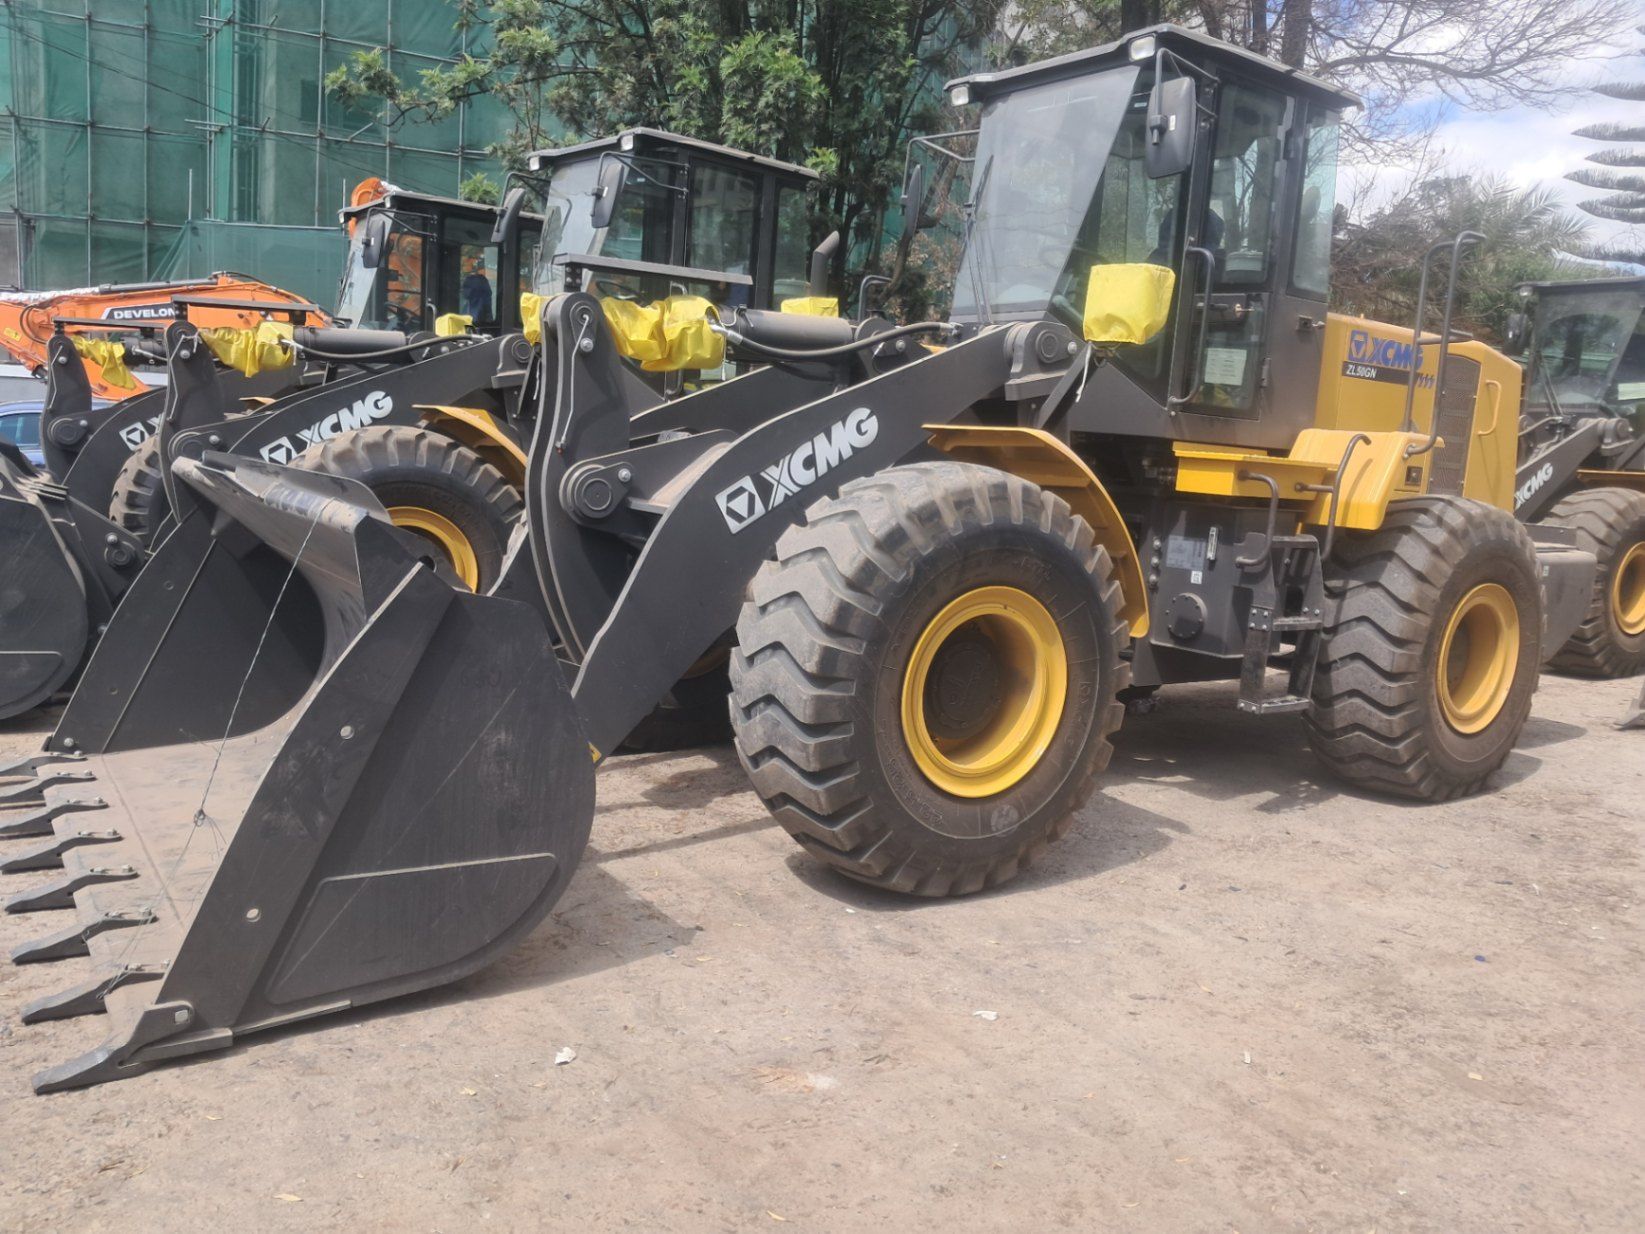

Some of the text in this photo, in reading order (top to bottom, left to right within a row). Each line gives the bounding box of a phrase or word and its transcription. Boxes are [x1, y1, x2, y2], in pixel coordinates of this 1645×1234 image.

[113, 307, 175, 319] DEVELON
[1346, 364, 1378, 379] ZL50GN
[295, 390, 393, 447] XCMG
[760, 407, 879, 511] XCMG
[1514, 463, 1553, 509] XCMG
